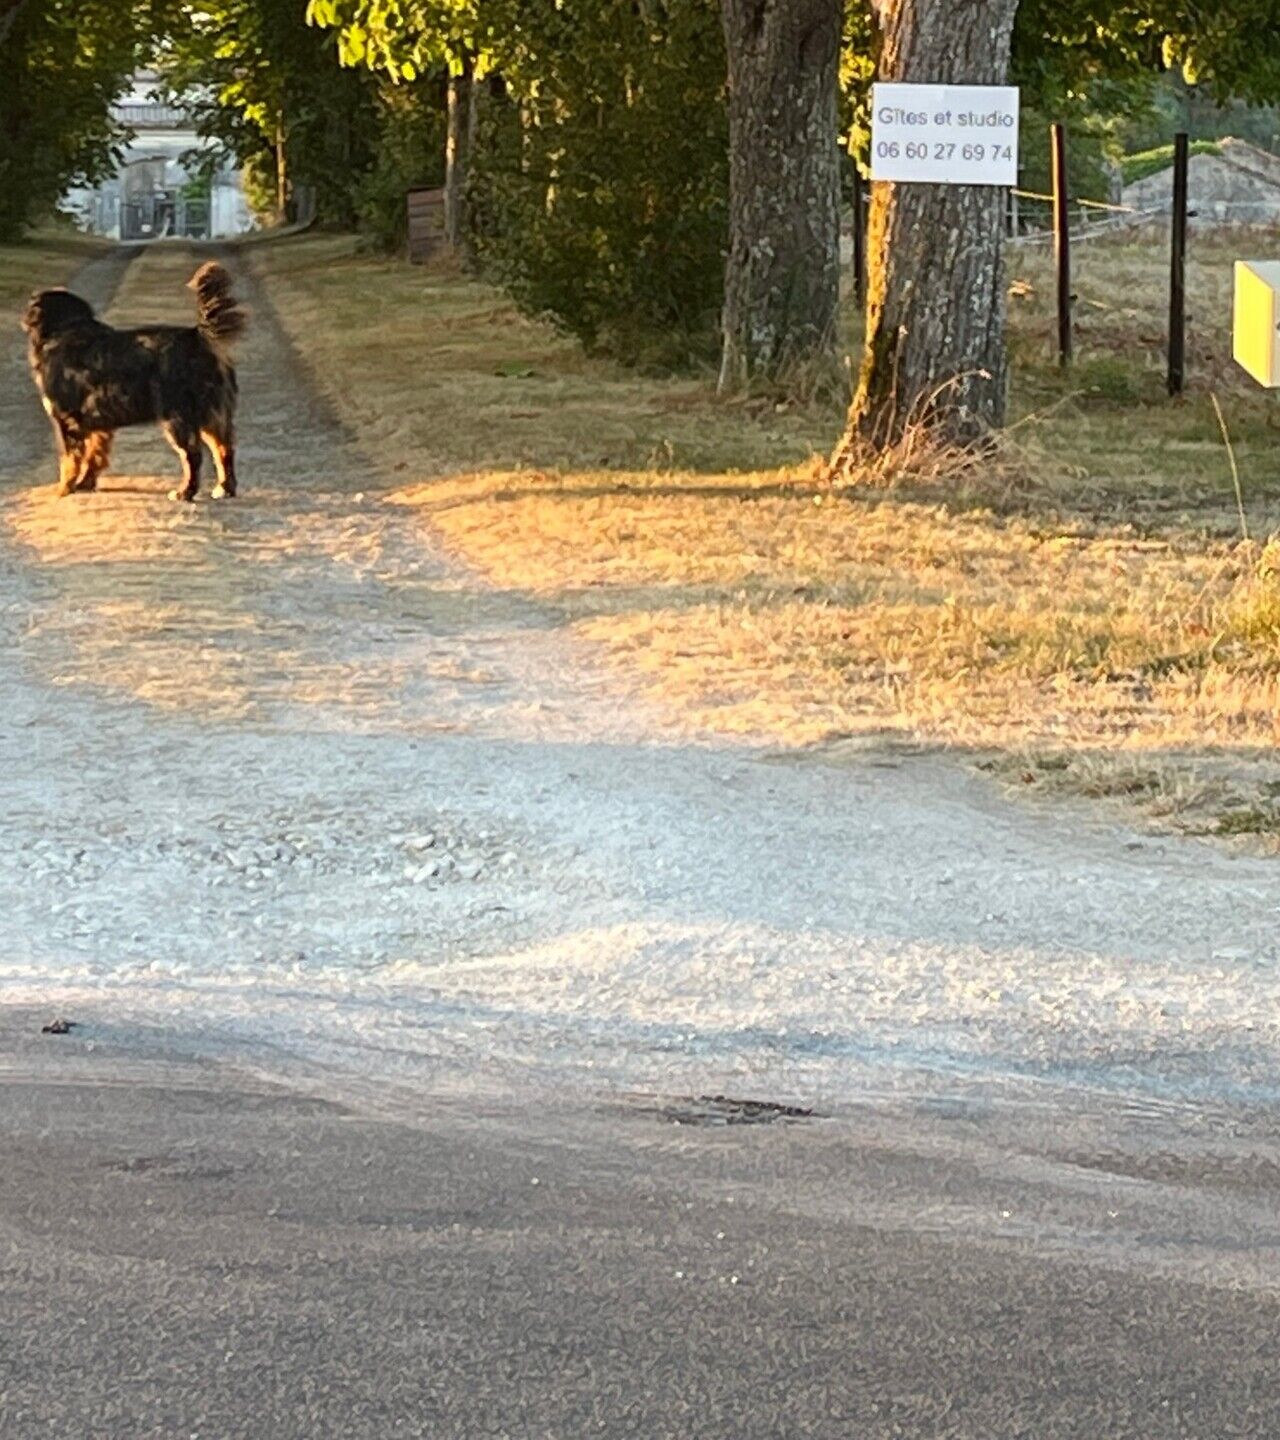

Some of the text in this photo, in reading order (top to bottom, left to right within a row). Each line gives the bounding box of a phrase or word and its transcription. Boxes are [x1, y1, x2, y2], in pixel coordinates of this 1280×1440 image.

[933, 109, 951, 126] et
[958, 111, 1015, 128] studio
[876, 141, 1012, 162] 06 60 27 69 74
